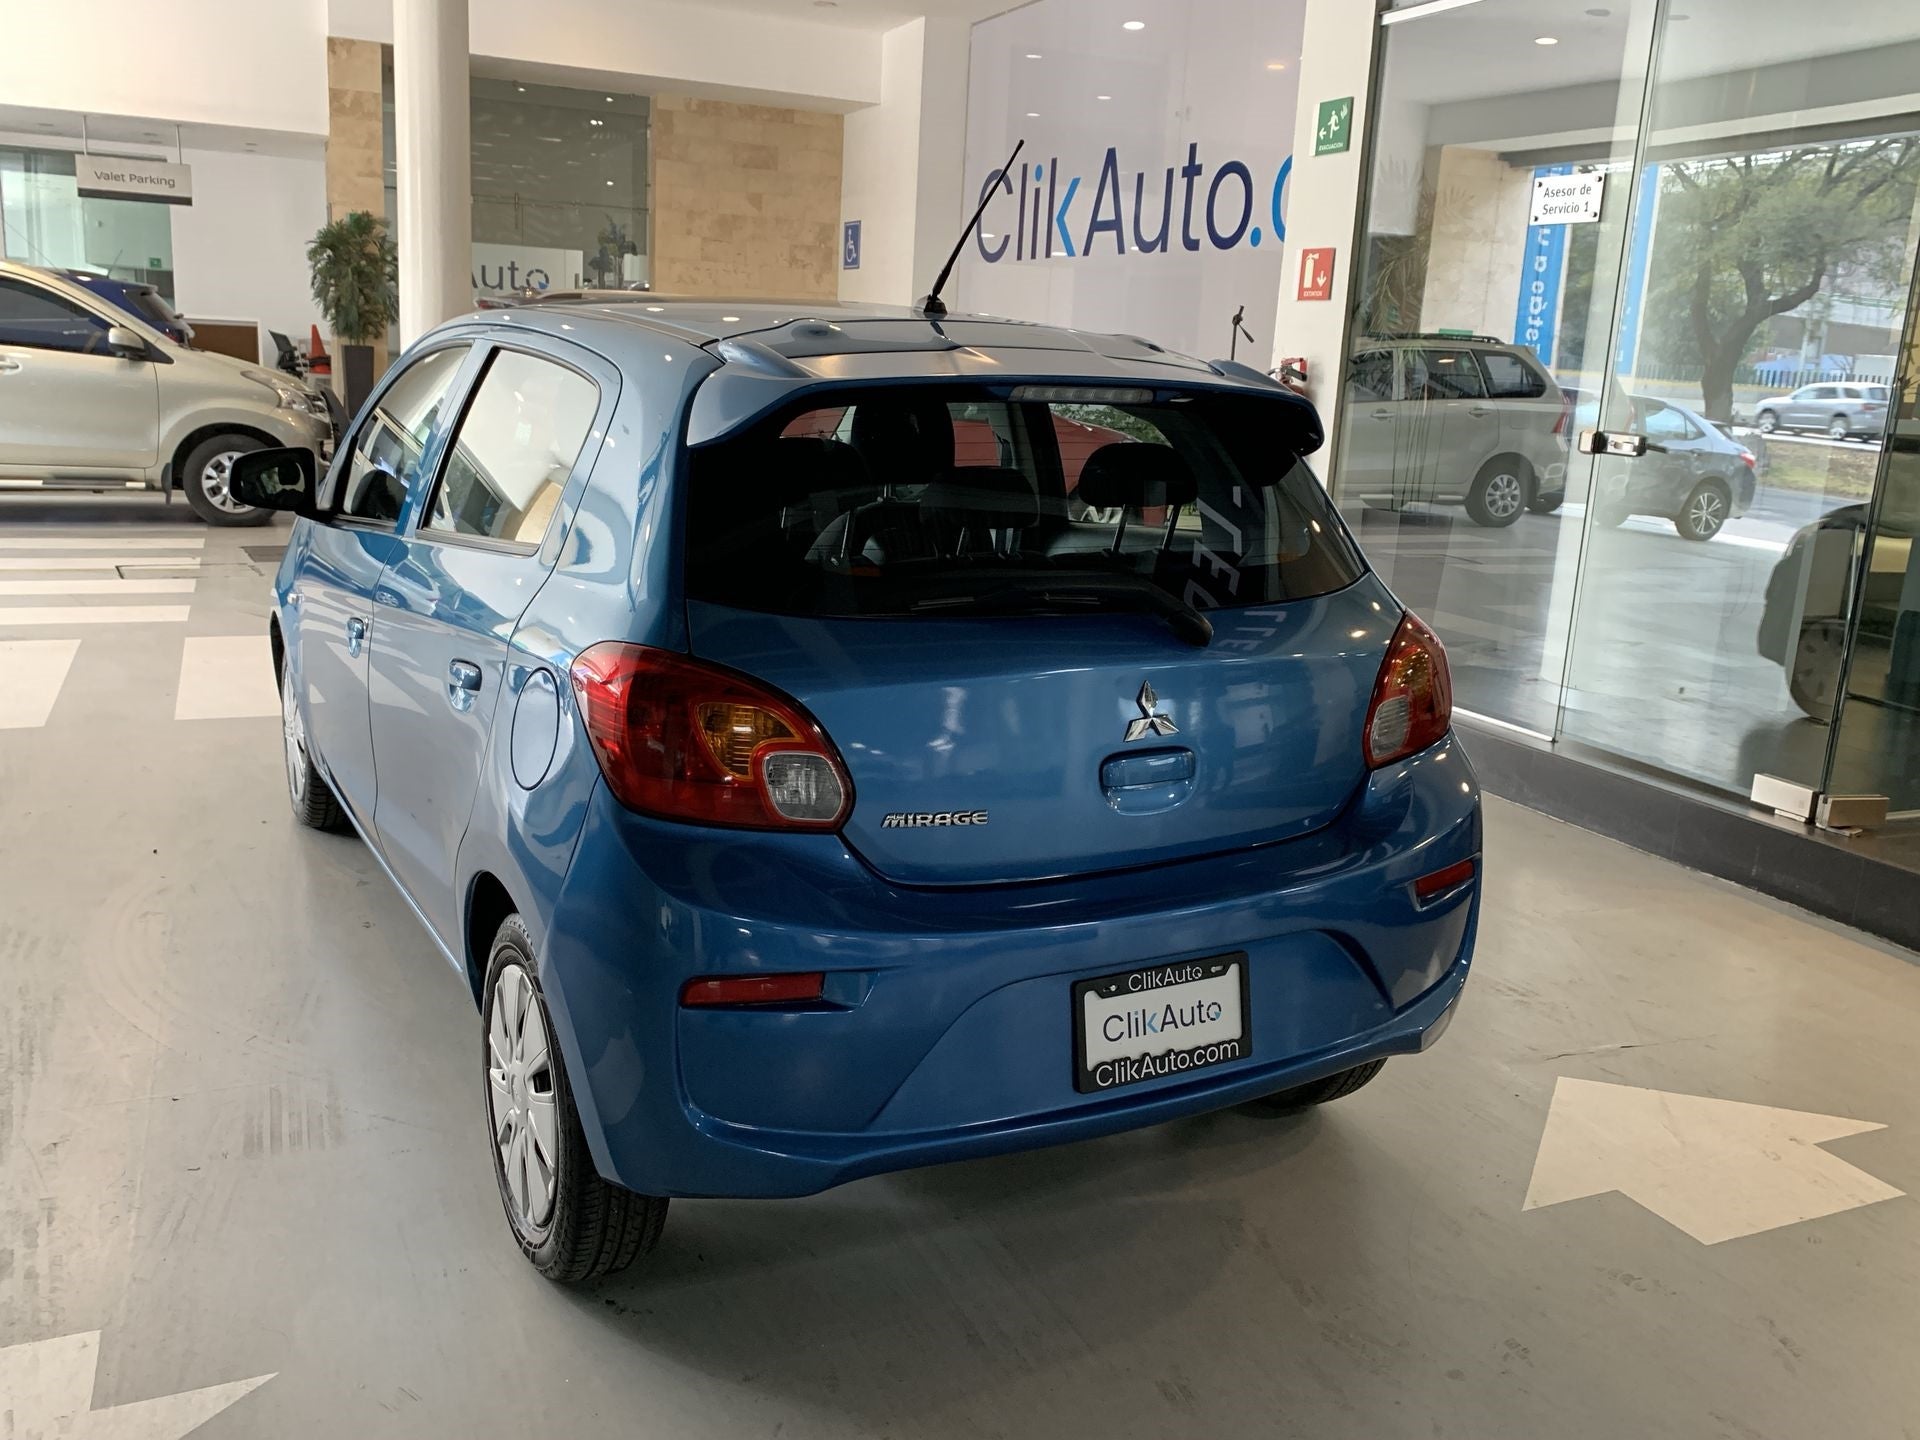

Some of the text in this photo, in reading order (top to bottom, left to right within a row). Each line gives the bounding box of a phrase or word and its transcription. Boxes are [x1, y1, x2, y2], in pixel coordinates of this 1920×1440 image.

[94, 170, 176, 189] Valet Parking
[1543, 184, 1592, 198] Asesor de
[1542, 201, 1589, 215] Servicio 1
[881, 809, 988, 828] MIRAGE
[1128, 965, 1203, 991] ClikAuto
[1103, 1000, 1222, 1042] ClikAuto
[1095, 1041, 1239, 1086] ClikAuto.com
